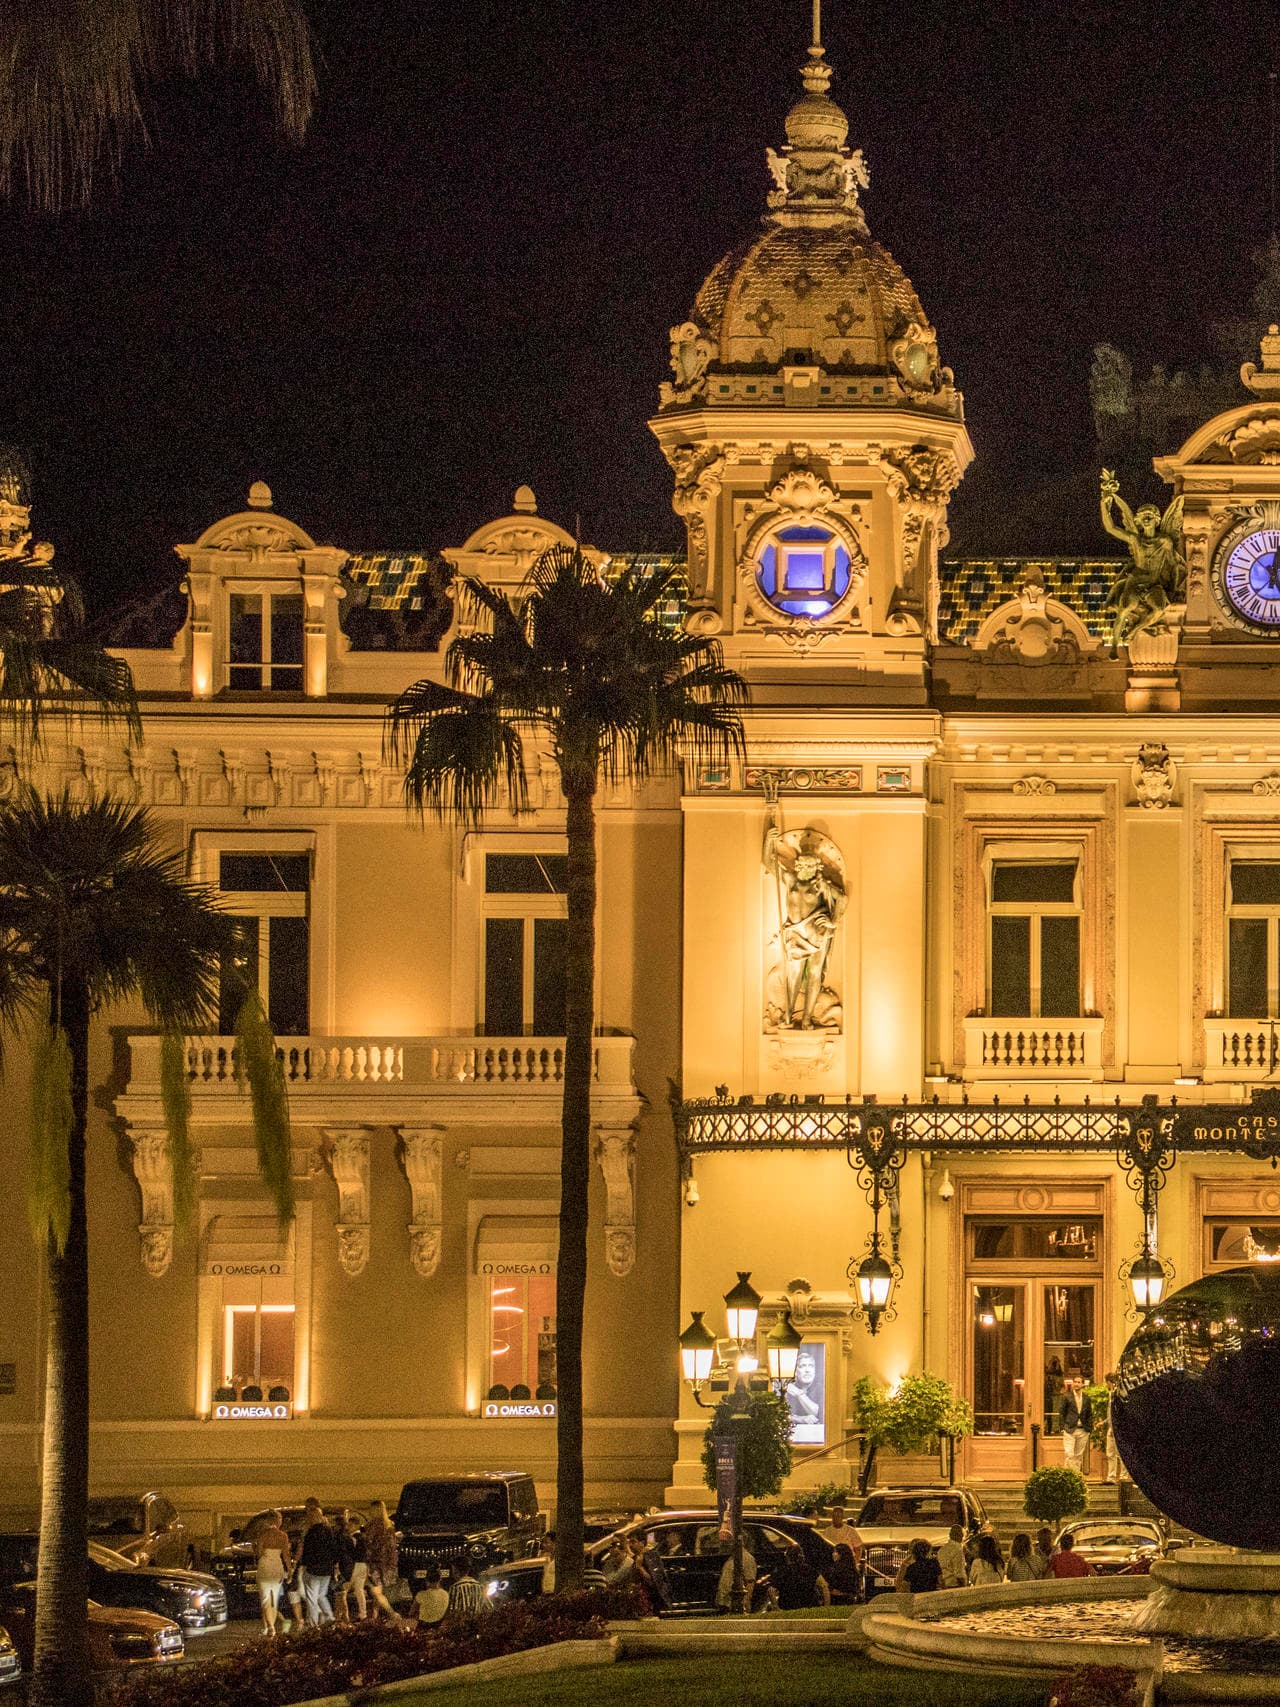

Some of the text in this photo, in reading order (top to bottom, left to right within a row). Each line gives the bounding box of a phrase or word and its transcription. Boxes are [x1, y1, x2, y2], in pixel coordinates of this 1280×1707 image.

[225, 1265, 267, 1275] OMEGA
[495, 1264, 537, 1274] OMEGA
[231, 1406, 273, 1418] OMEGA
[500, 1405, 541, 1416] OMEGA
